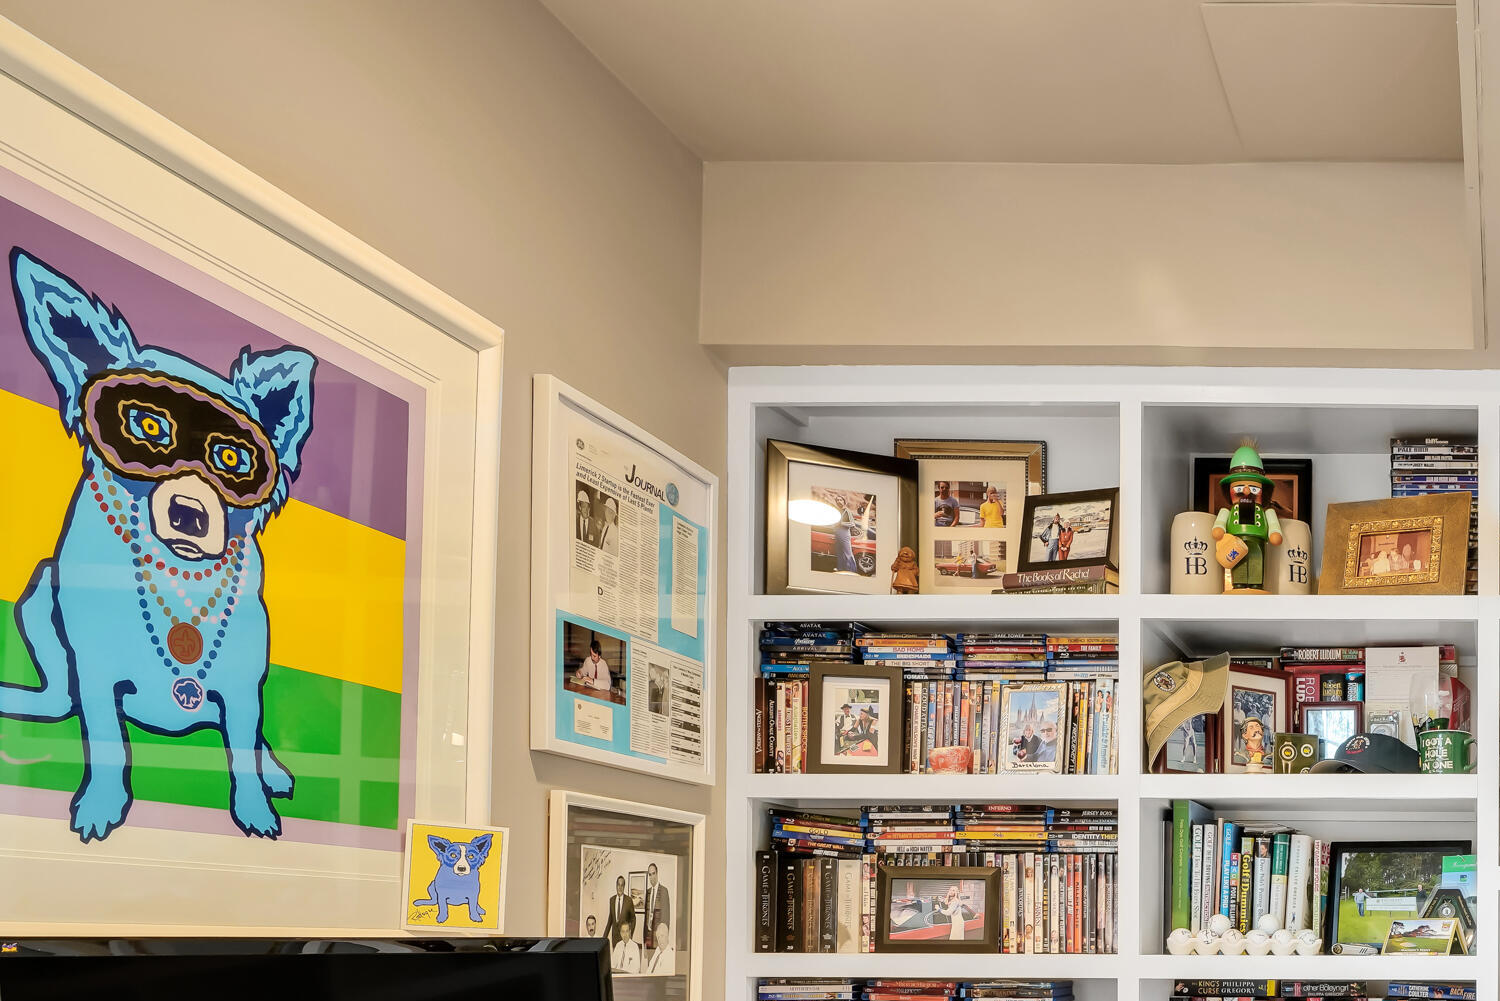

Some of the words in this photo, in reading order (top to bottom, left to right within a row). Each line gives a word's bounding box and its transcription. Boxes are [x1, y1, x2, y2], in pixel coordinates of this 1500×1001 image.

[576, 462, 597, 478] Limerick
[602, 475, 617, 490] Startup
[630, 490, 646, 504] Fastest
[646, 498, 656, 508] Ever
[576, 471, 586, 480] and
[587, 475, 599, 487] Least
[600, 481, 622, 500] Expensive
[628, 496, 637, 506] Last
[641, 503, 654, 515] Plants
[625, 464, 666, 503] JOURNAL
[1184, 557, 1208, 575] HB
[1289, 564, 1308, 584] HB
[1298, 648, 1319, 660] ROBERT
[1319, 648, 1342, 660] LUDLUM
[1322, 682, 1342, 690] Robert
[1426, 738, 1443, 747] GOT
[1444, 736, 1453, 746] A
[1425, 749, 1448, 758] HOLE
[1010, 761, 1050, 770] Barcelona
[1422, 761, 1432, 770] IN
[1432, 760, 1453, 769] ONE
[1242, 855, 1251, 878] Golf
[787, 873, 796, 894] GAME
[824, 872, 833, 892] GAME
[786, 898, 795, 931] THRONES
[824, 897, 832, 929] THRONES
[1239, 883, 1251, 935] Dummies
[1409, 984, 1430, 992] CATHERINE
